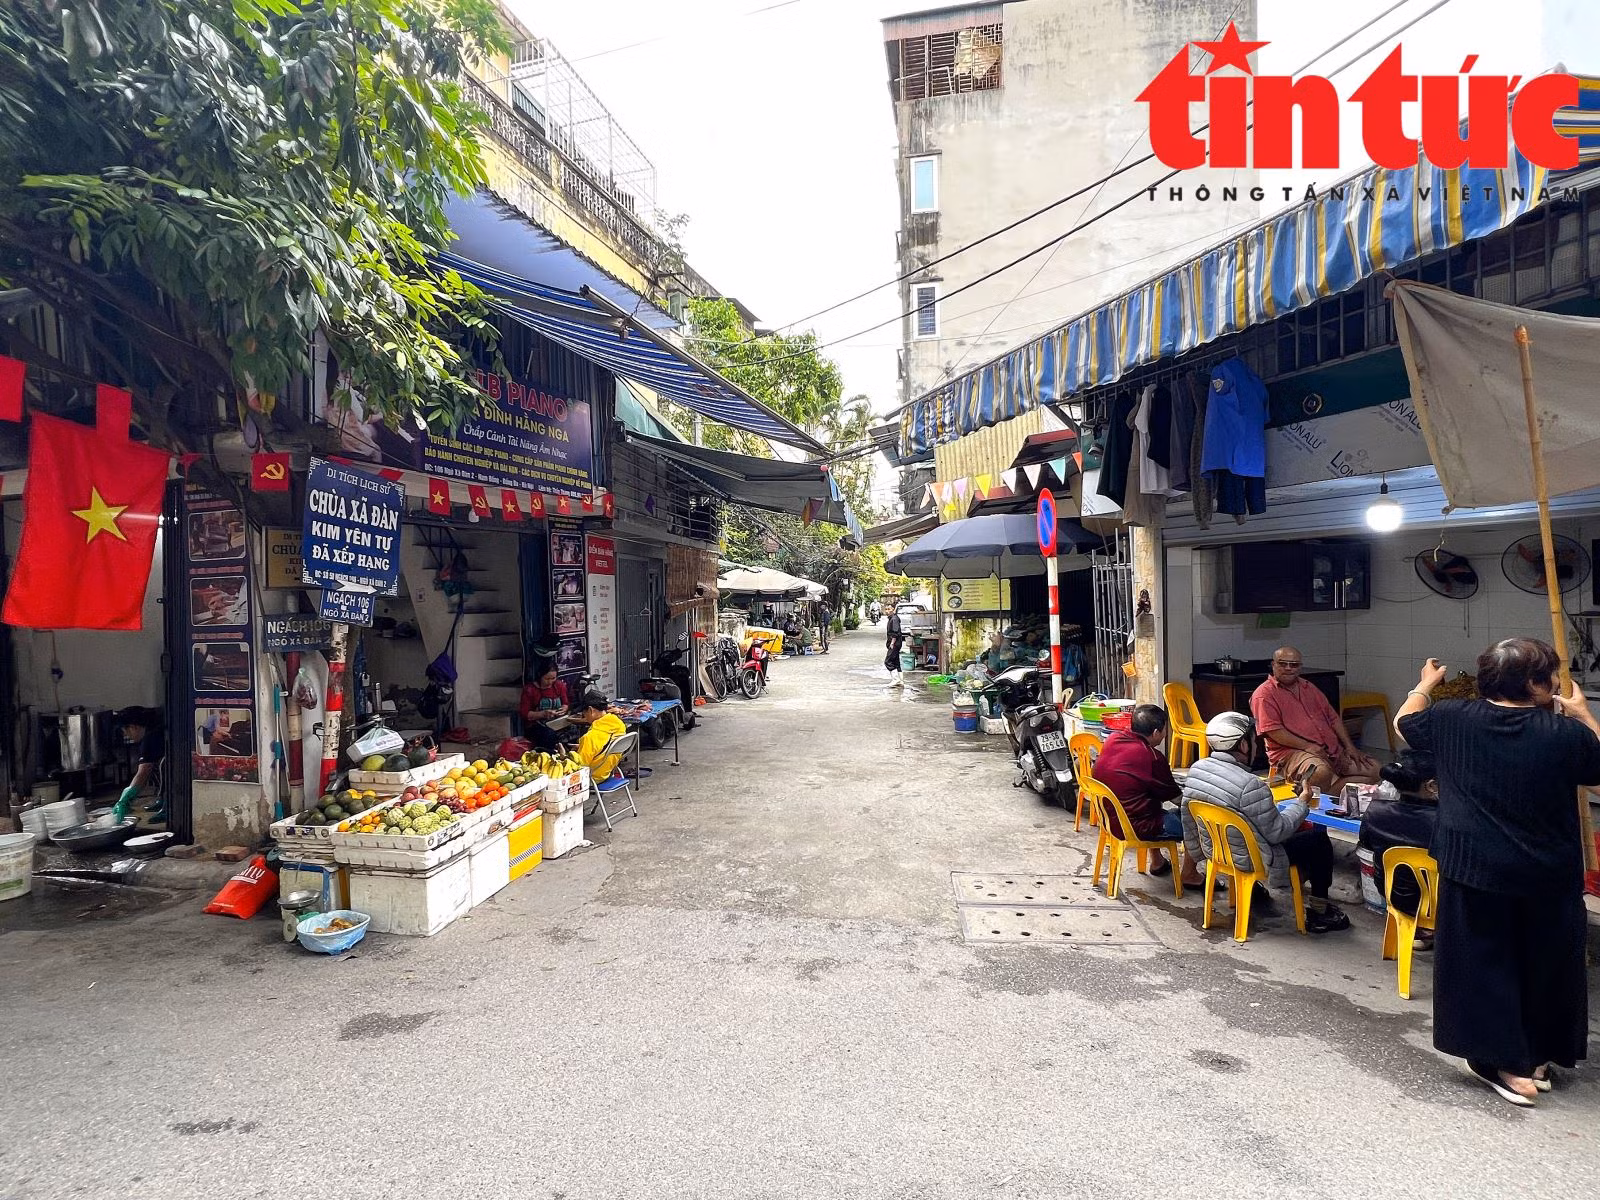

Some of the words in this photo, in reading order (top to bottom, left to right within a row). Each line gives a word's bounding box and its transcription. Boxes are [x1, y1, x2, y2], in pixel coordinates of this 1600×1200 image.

[475, 368, 501, 401] LB
[507, 380, 568, 423] PIANO
[1389, 399, 1422, 430] ONALU
[486, 428, 506, 444] Cánh
[549, 425, 569, 442] NGA
[1289, 422, 1322, 449] ONALU
[326, 468, 337, 479] DI
[339, 470, 359, 486] TÍCH
[360, 478, 379, 492] LỊCH
[309, 488, 347, 520] CHÙA
[349, 496, 369, 525] XÃ
[371, 502, 399, 532] ĐÀN
[311, 520, 341, 541] KIM
[345, 528, 372, 547] YÊN
[375, 535, 394, 554] TỰ
[312, 543, 330, 561] ĐÃ
[332, 545, 356, 565] XẾP
[357, 554, 390, 571] HẠNG
[357, 596, 370, 609] 106
[267, 616, 308, 634] NGÁCH
[365, 614, 369, 622] 2
